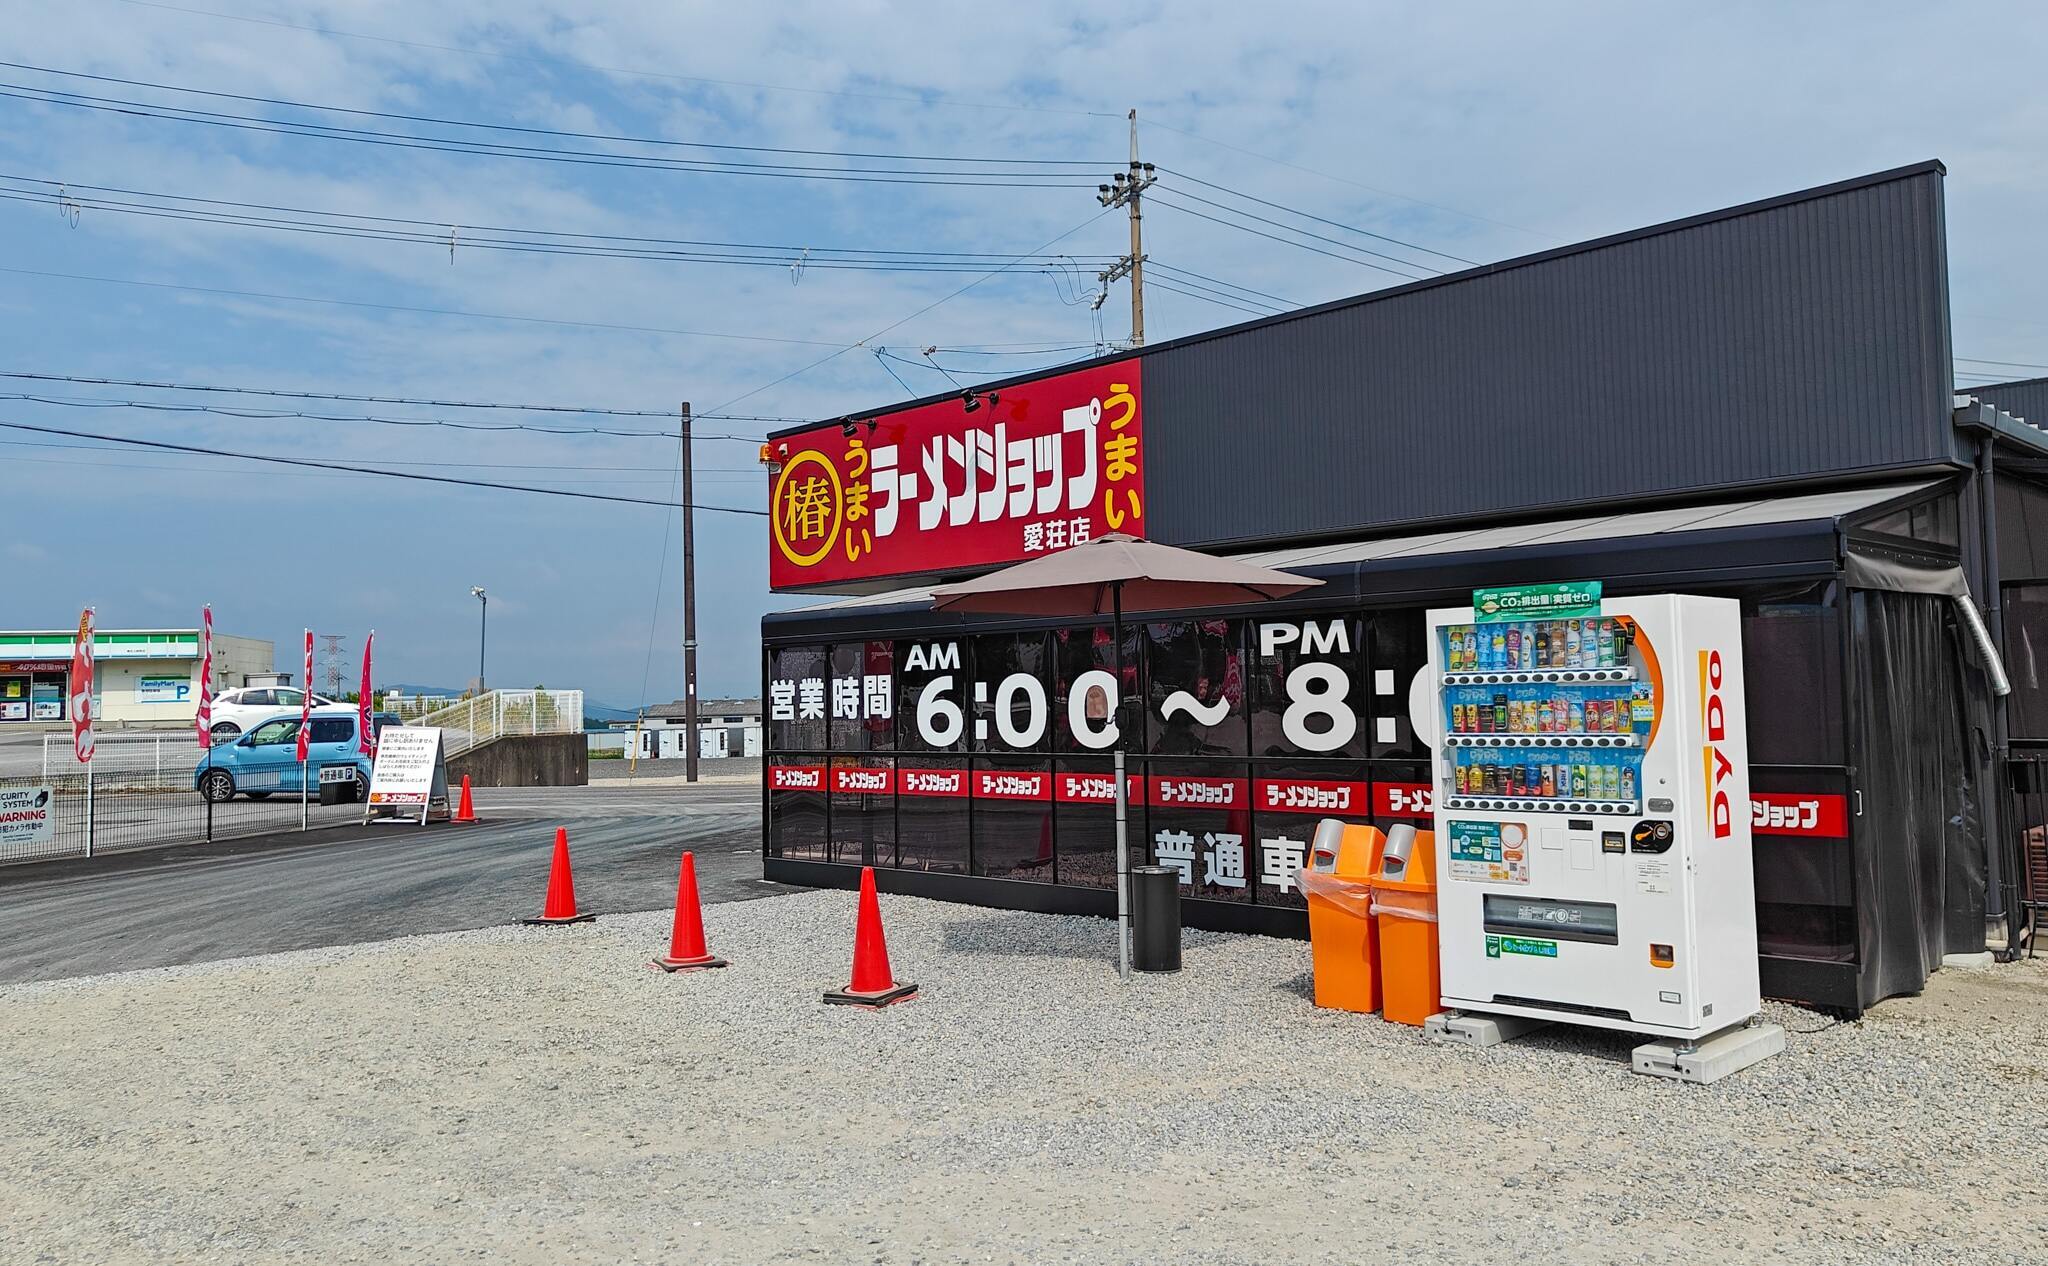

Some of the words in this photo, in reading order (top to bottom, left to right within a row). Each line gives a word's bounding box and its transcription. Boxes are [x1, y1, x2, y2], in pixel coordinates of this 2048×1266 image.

[871, 397, 1101, 537] ラーメンショップ
[1104, 383, 1142, 529] うまい
[784, 475, 832, 541] 椿
[844, 440, 872, 562] うまい
[1023, 516, 1091, 552] 愛荘店
[1260, 619, 1350, 656] PM
[904, 642, 961, 672] AM
[177, 686, 190, 699] P
[770, 674, 892, 721] 営業時間
[916, 670, 1121, 749] 6:00
[347, 769, 352, 779] P
[776, 770, 819, 787] ラーメンショップ
[839, 771, 887, 790] ラーメンショップ
[907, 773, 960, 792] ラーメンショップ
[982, 775, 1041, 795] ラーメンショップ
[0, 791, 29, 801] CURITY
[1066, 778, 1132, 799] ラーメンショ
[1161, 781, 1235, 804] ラーメンショップ
[1267, 784, 1351, 809] ラーメンショップ
[3, 800, 33, 808] SYSTEM
[1750, 800, 1819, 829] ショップ
[1155, 829, 1306, 893] 普通車
